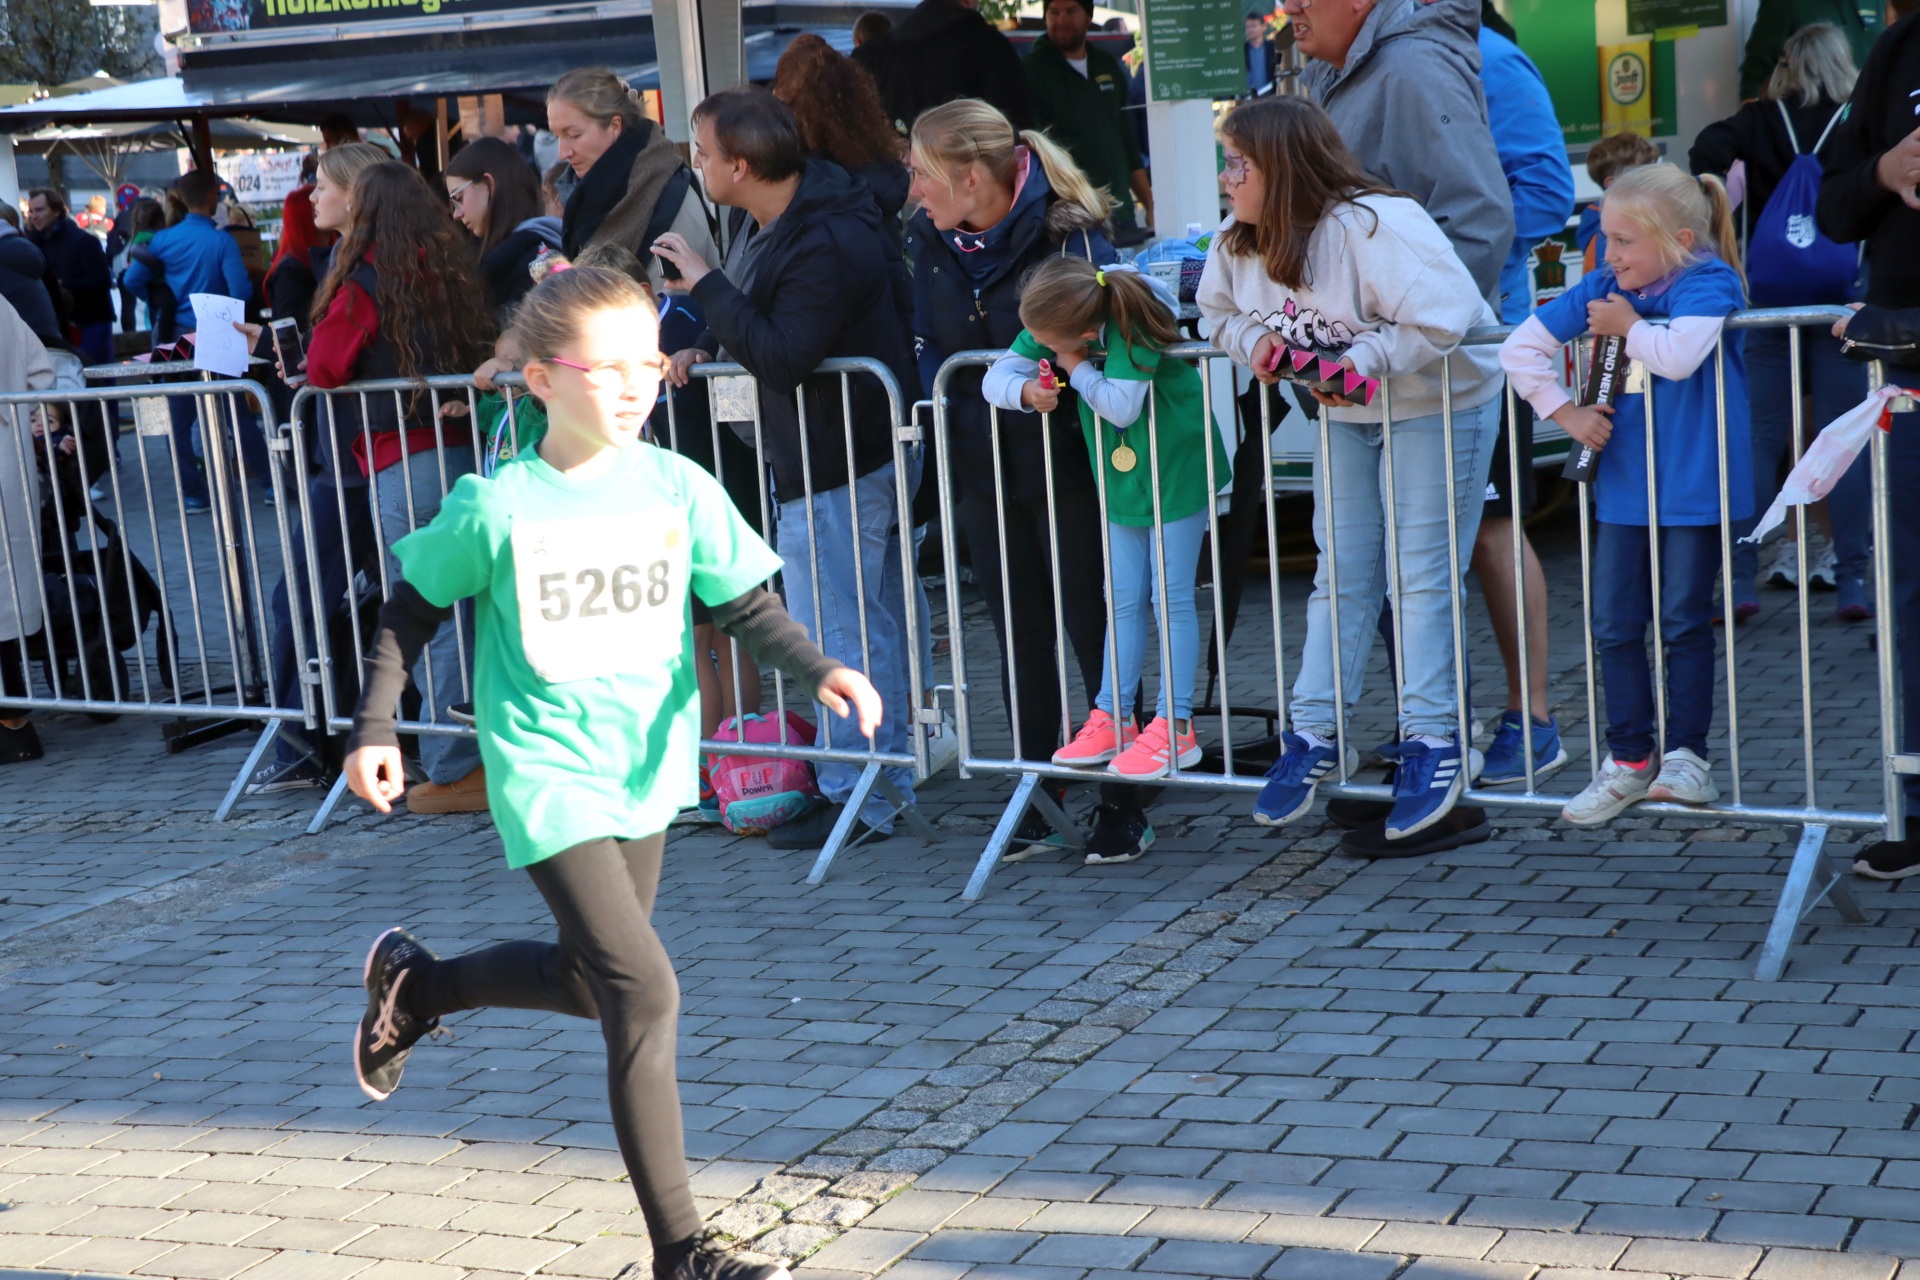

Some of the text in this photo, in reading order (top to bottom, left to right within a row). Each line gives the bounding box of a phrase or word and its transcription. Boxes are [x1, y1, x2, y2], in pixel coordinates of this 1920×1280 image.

[1604, 336, 1620, 371] FEND
[539, 559, 670, 622] 5268
[739, 767, 774, 788] PUP
